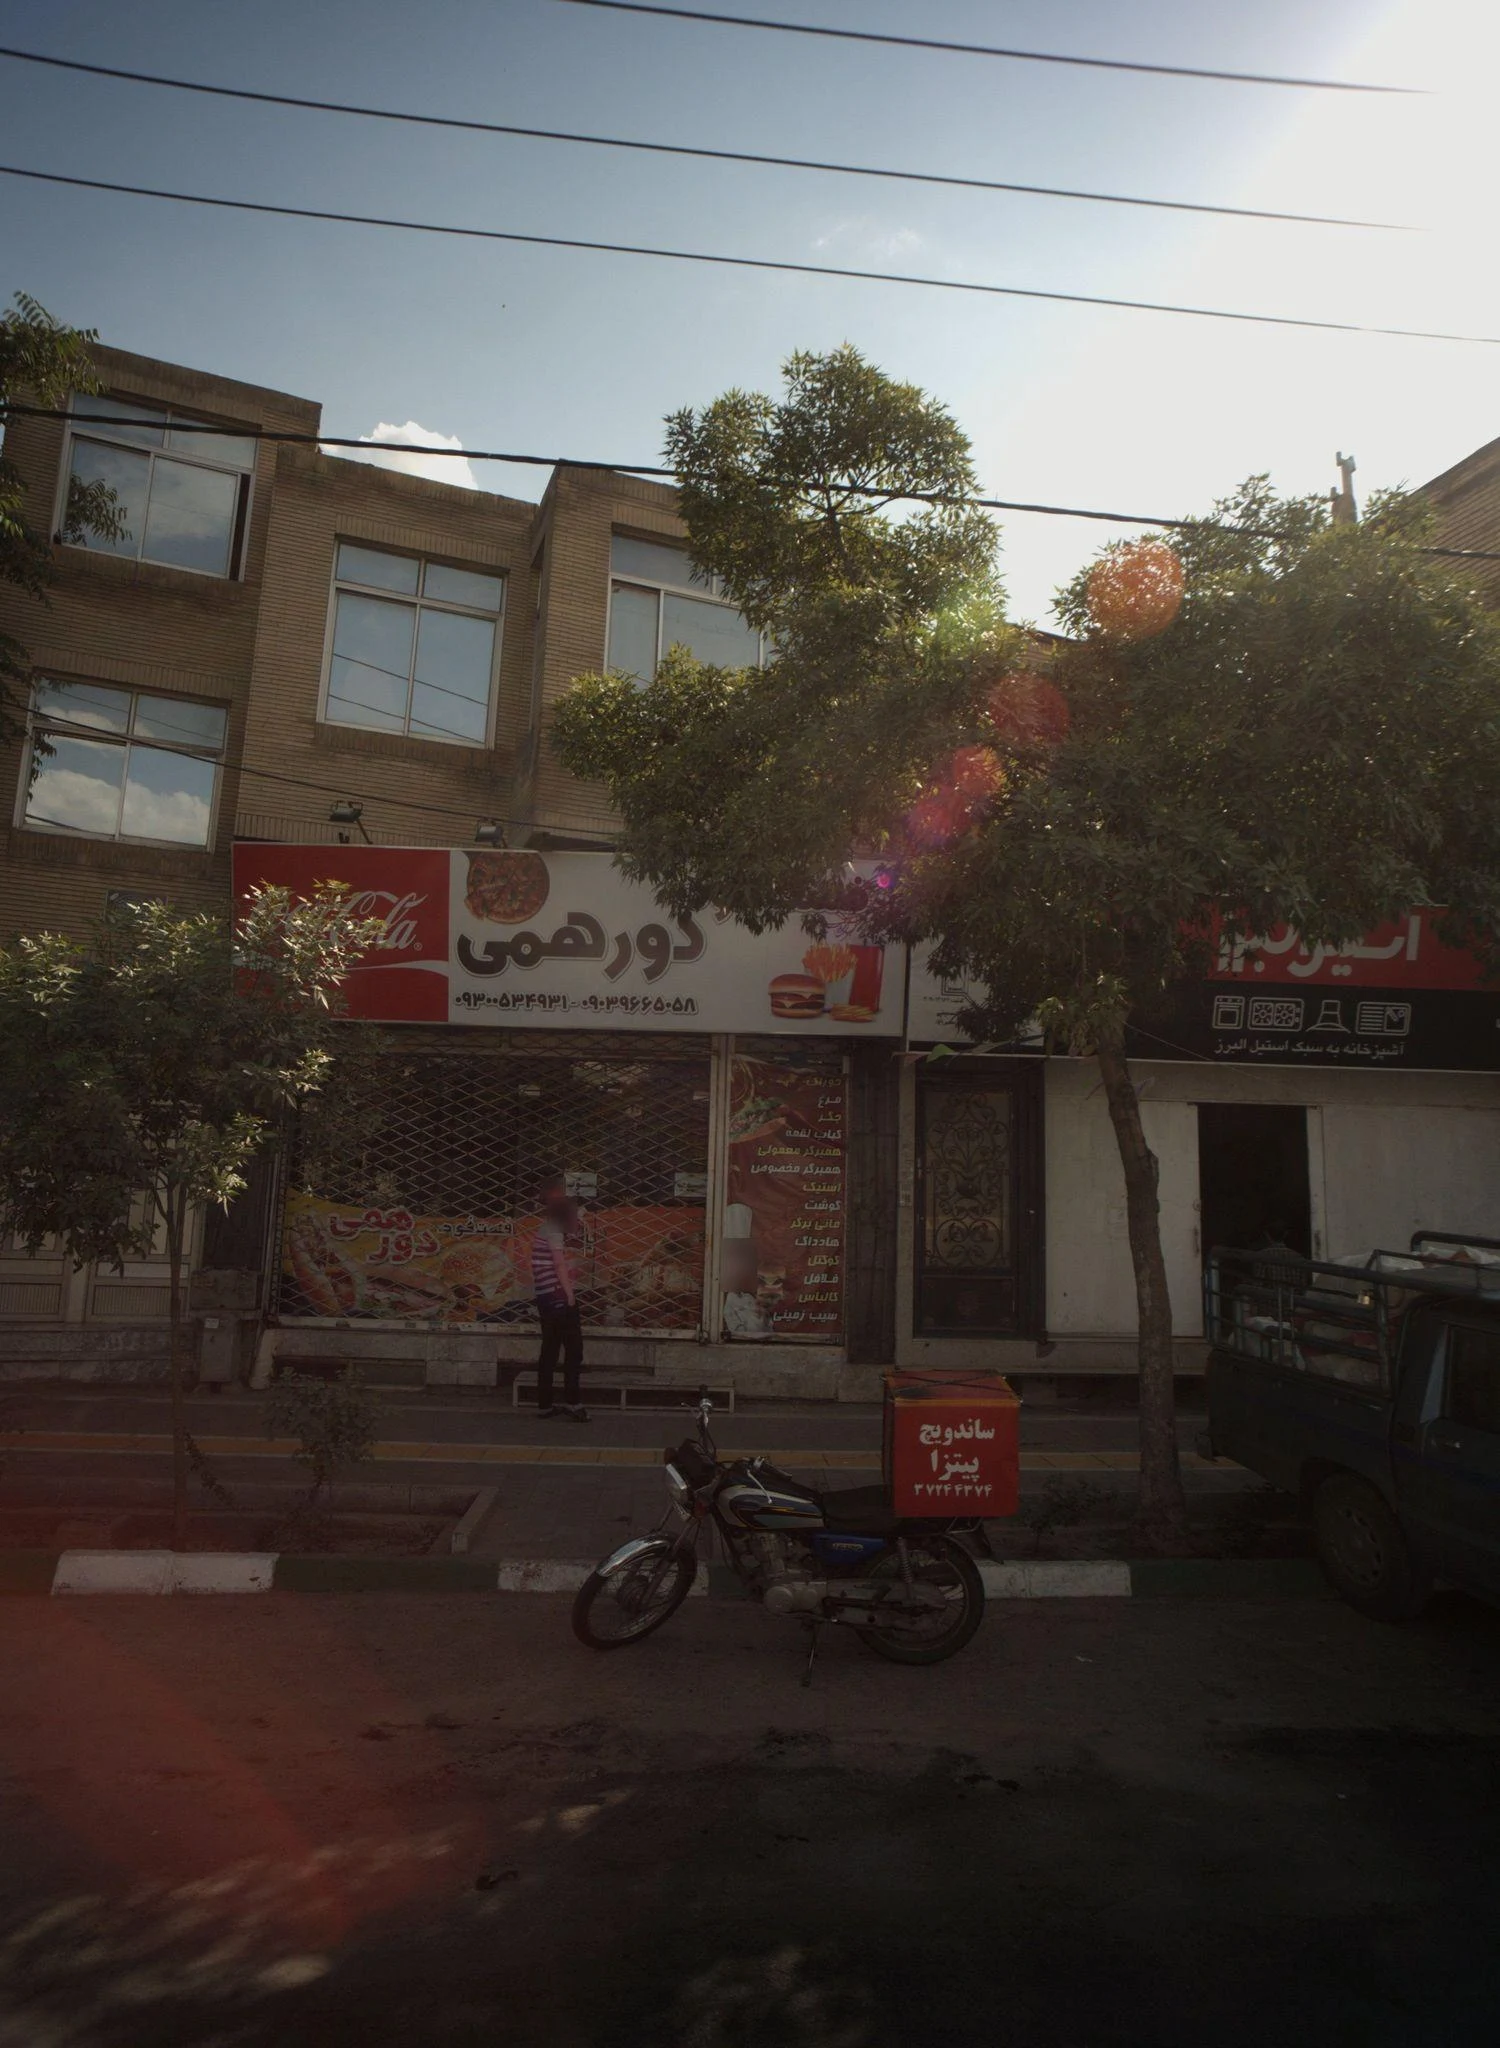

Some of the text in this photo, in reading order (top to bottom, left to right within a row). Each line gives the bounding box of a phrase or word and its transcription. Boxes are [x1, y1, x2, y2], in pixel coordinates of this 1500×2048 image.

[1213, 1038, 1247, 1054] البرز
[1249, 1040, 1289, 1056] استیل
[1291, 1042, 1323, 1056] سبک
[1326, 1044, 1340, 1057] به
[757, 1144, 841, 1158] همبرگر معمولی
[750, 1162, 841, 1175] همبرگر مخصوص
[802, 1181, 841, 1193] استیک
[803, 1272, 839, 1285] فلافل
[798, 1291, 839, 1304] کالباس
[773, 1309, 838, 1322] سیب زمینی
[918, 1418, 996, 1446] ساندویچ
[929, 1448, 980, 1483] پیتزا
